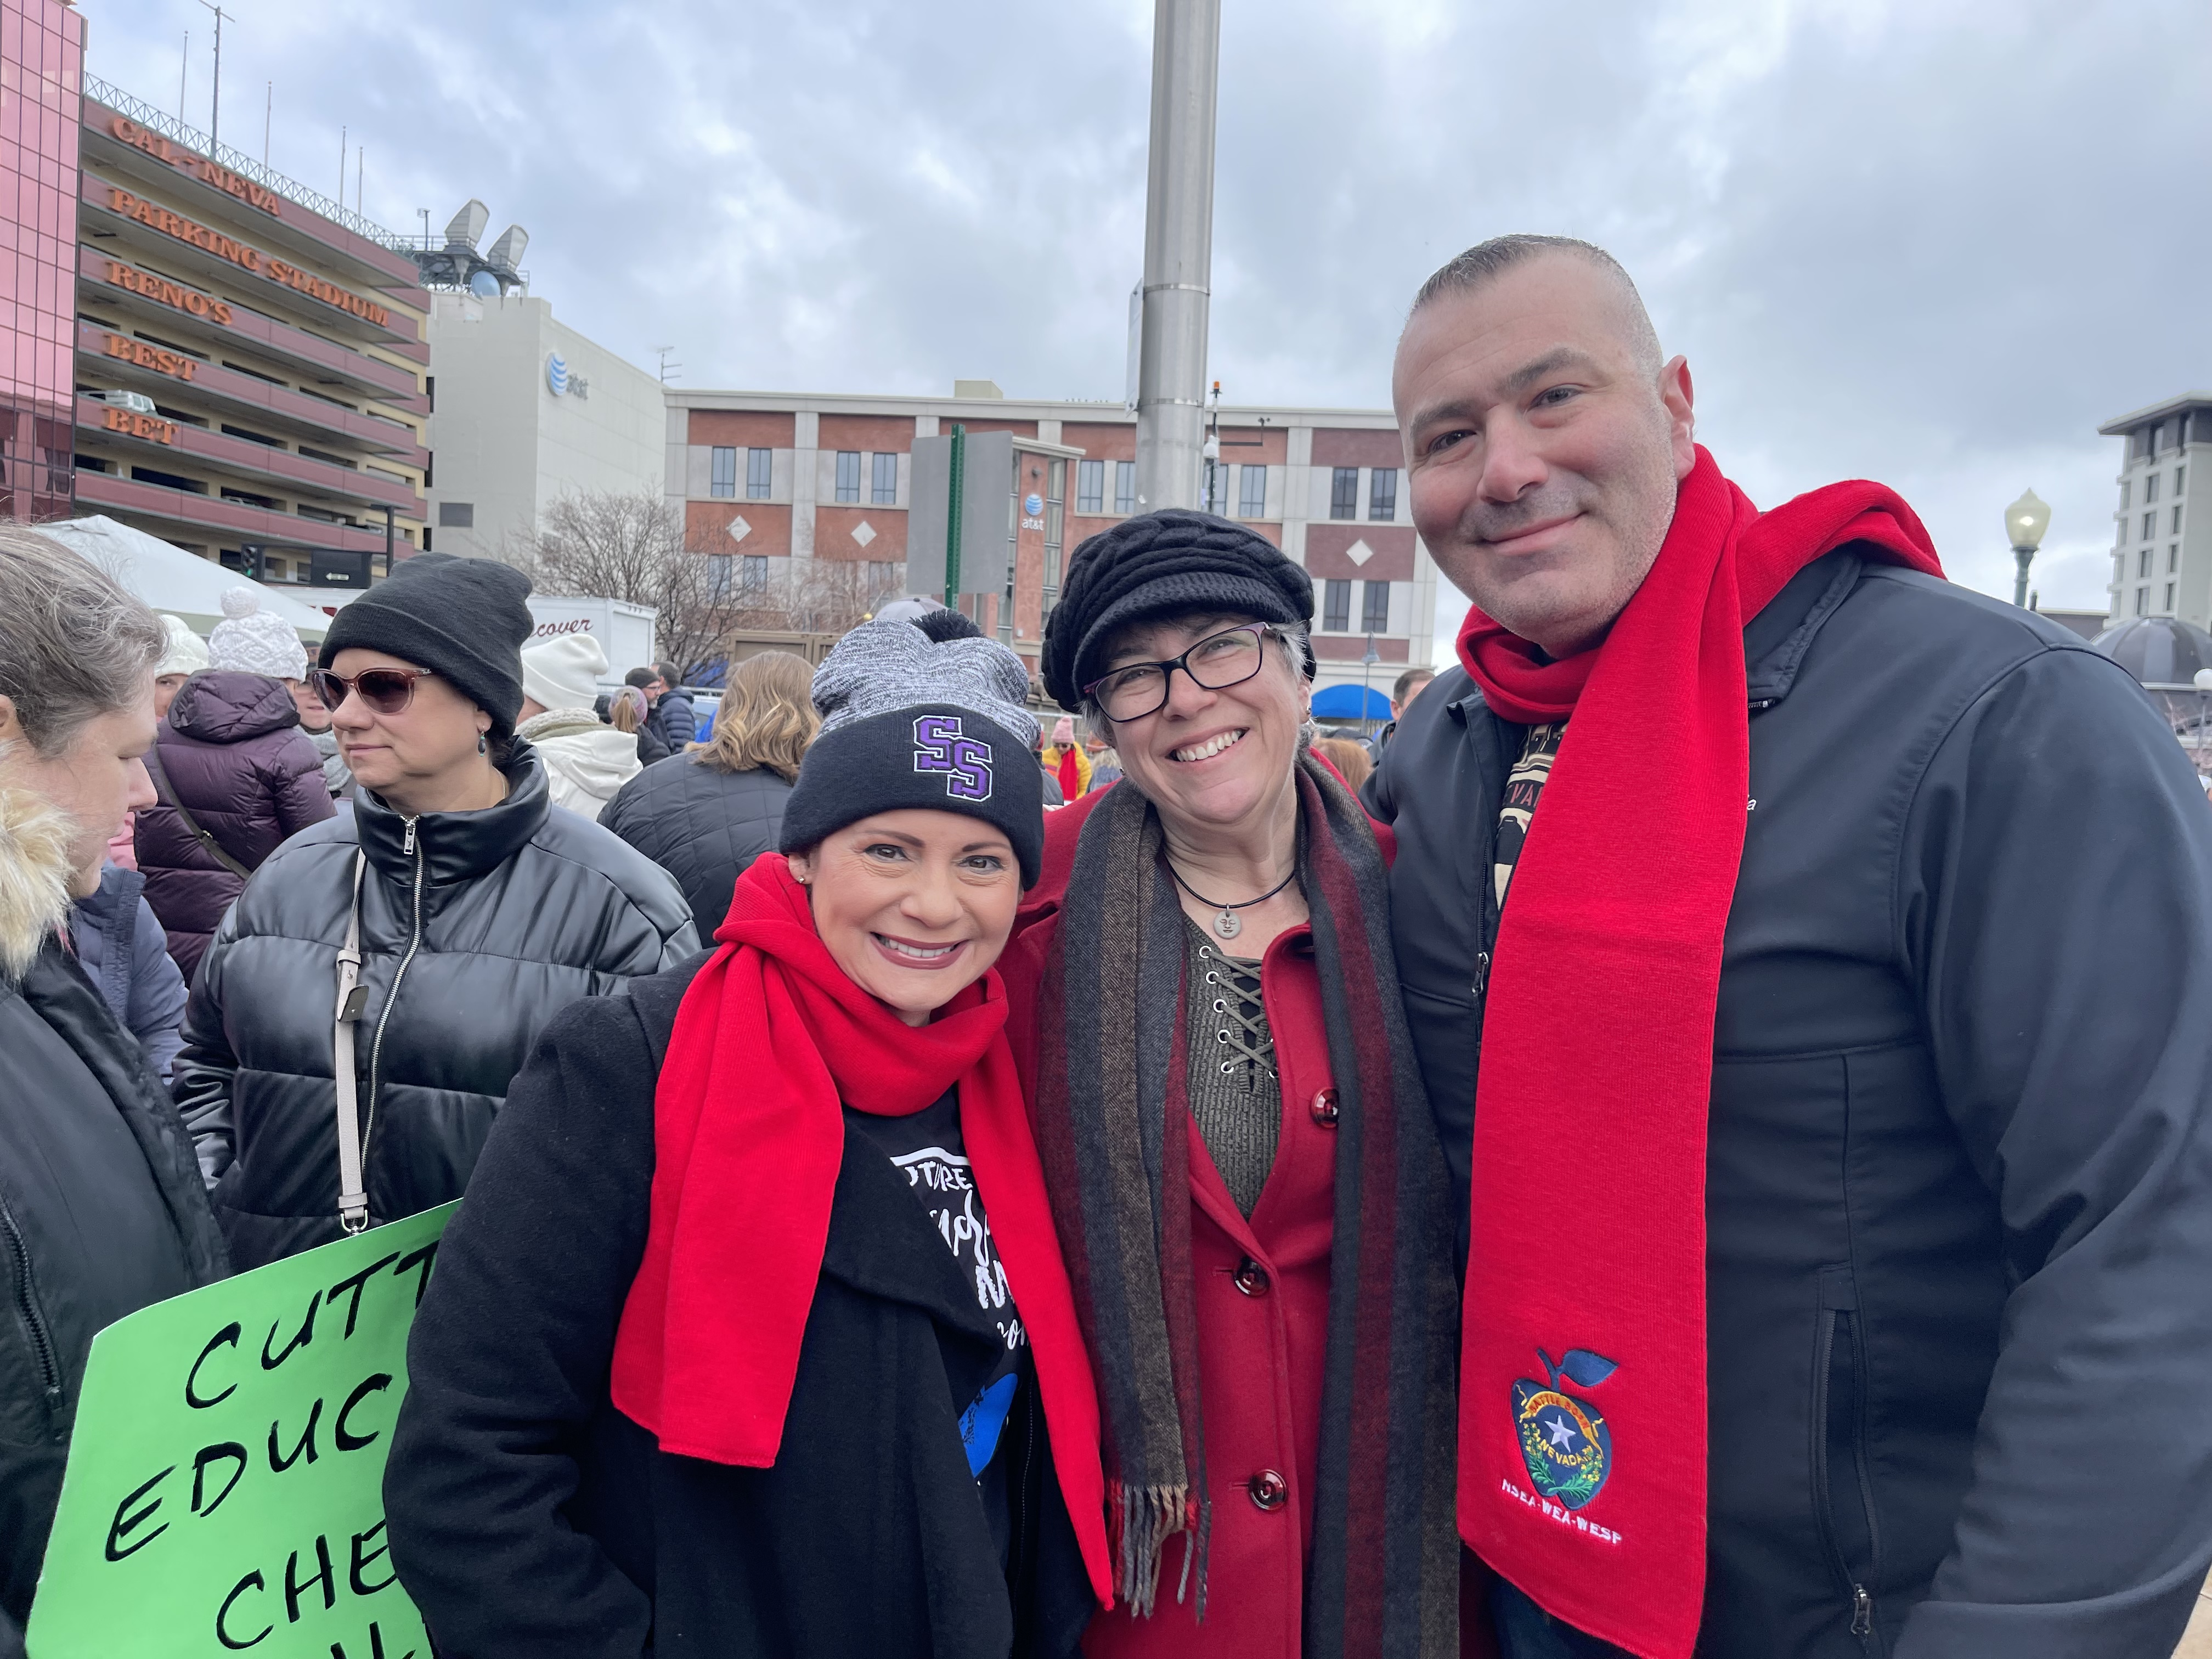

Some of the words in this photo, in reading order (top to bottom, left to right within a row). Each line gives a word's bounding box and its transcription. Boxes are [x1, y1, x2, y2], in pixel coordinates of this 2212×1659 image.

[107, 187, 261, 272] PARKING
[267, 258, 390, 328] STADIUM
[105, 261, 234, 326] RENO'S
[104, 332, 200, 381] BEST
[103, 408, 178, 445] BET
[1022, 517, 1044, 531] at&t
[530, 619, 594, 637] cover
[105, 1373, 393, 1562] EDUC
[1539, 1438, 1585, 1466] NEVADA
[216, 1519, 397, 1650] CHE
